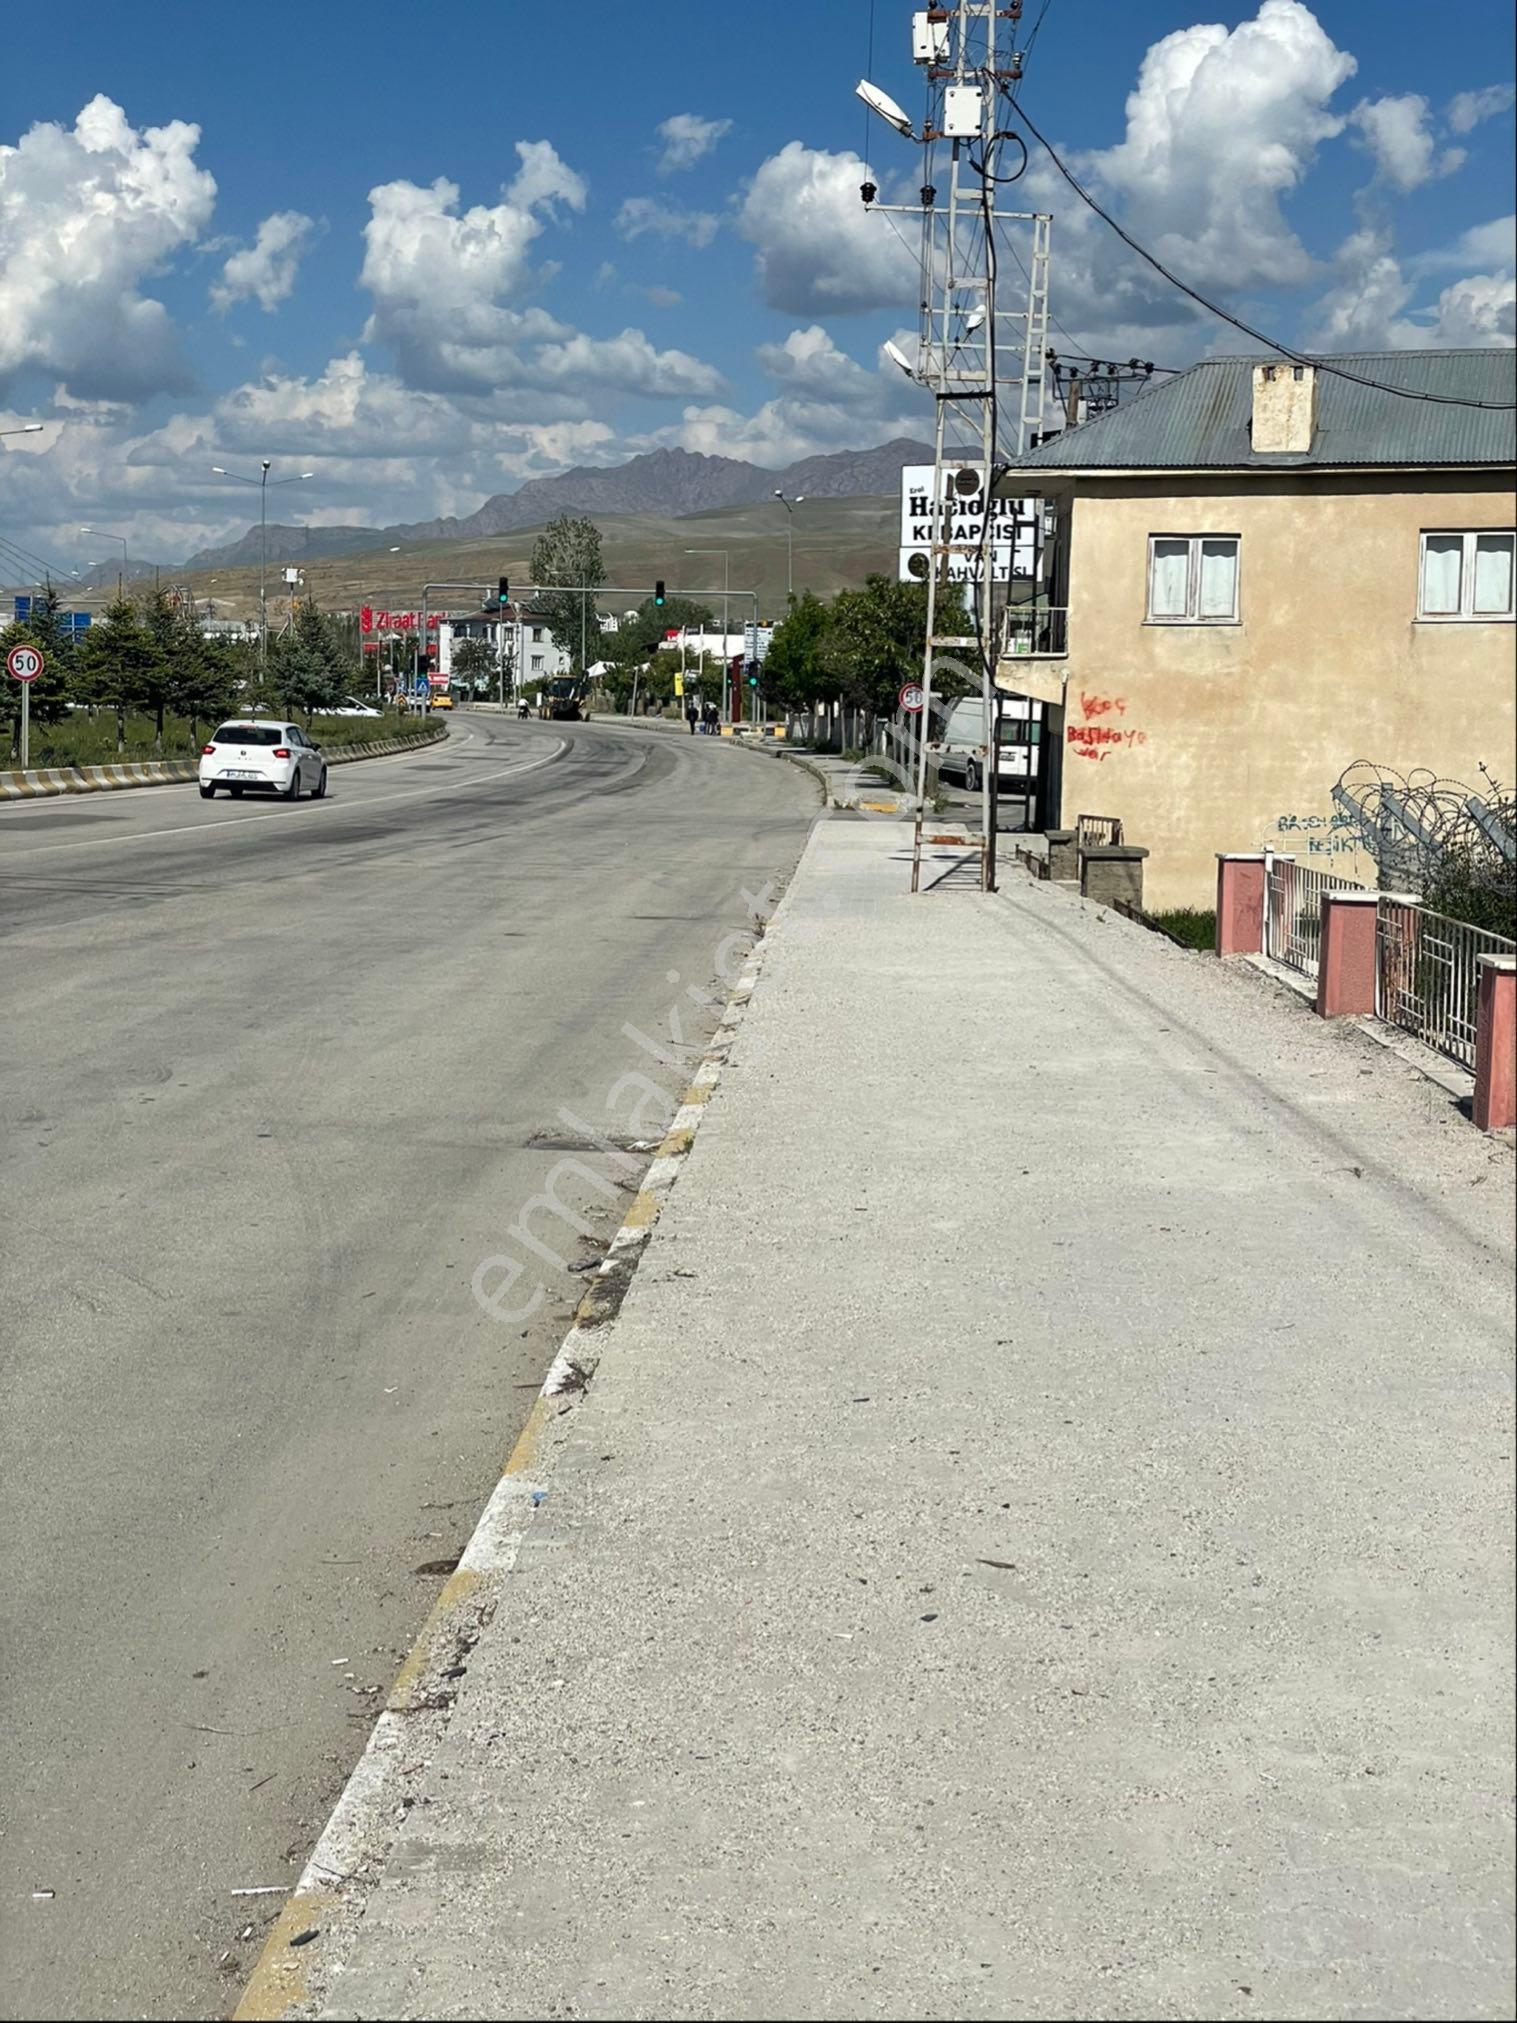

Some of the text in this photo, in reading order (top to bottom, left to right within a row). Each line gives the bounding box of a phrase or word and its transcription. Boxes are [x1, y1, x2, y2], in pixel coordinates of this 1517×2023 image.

[935, 566, 1027, 580] KAHVALTSI
[15, 655, 37, 671] 50
[905, 688, 923, 704] 50
